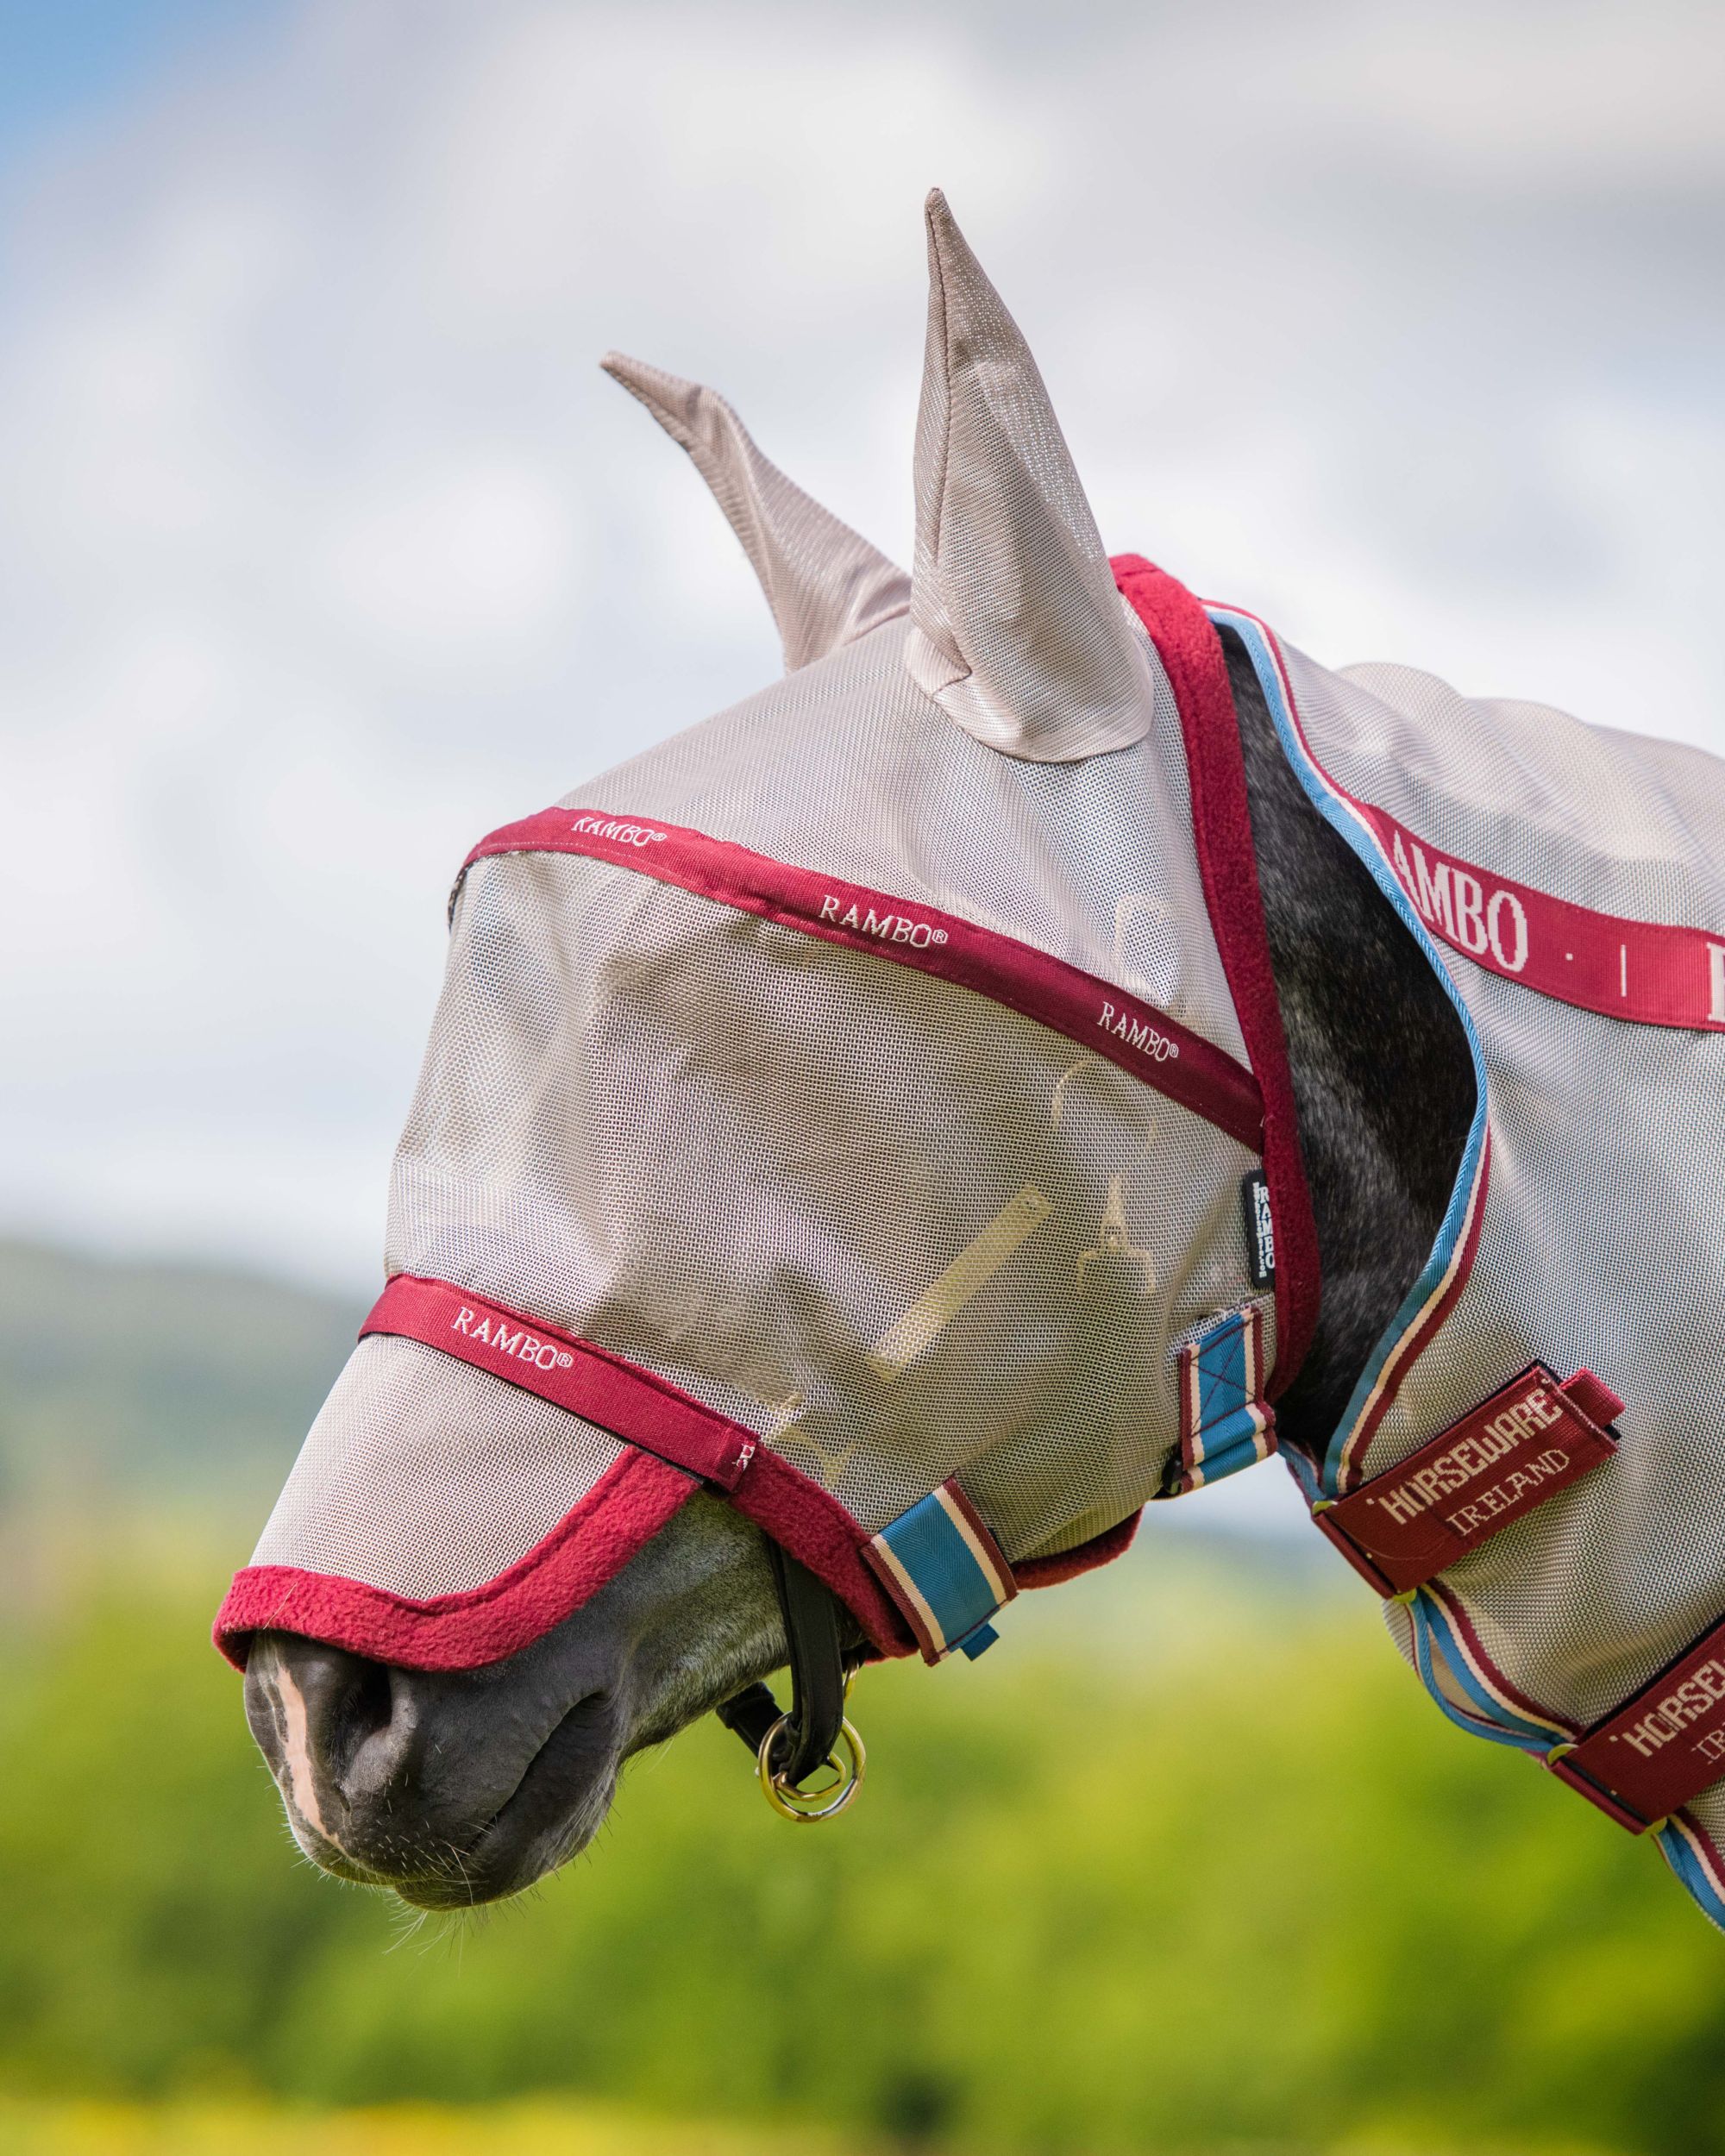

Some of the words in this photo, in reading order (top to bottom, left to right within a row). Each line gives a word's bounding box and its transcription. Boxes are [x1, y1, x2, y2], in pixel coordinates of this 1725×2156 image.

[819, 894, 948, 948] RAMBO®
[1097, 1001, 1179, 1062] RAMBO®
[1259, 1186, 1276, 1269] RAMBO
[451, 1307, 574, 1369] RAMBO®
[1446, 1450, 1571, 1536] IRELAND
[1690, 1722, 1725, 1764] IR
